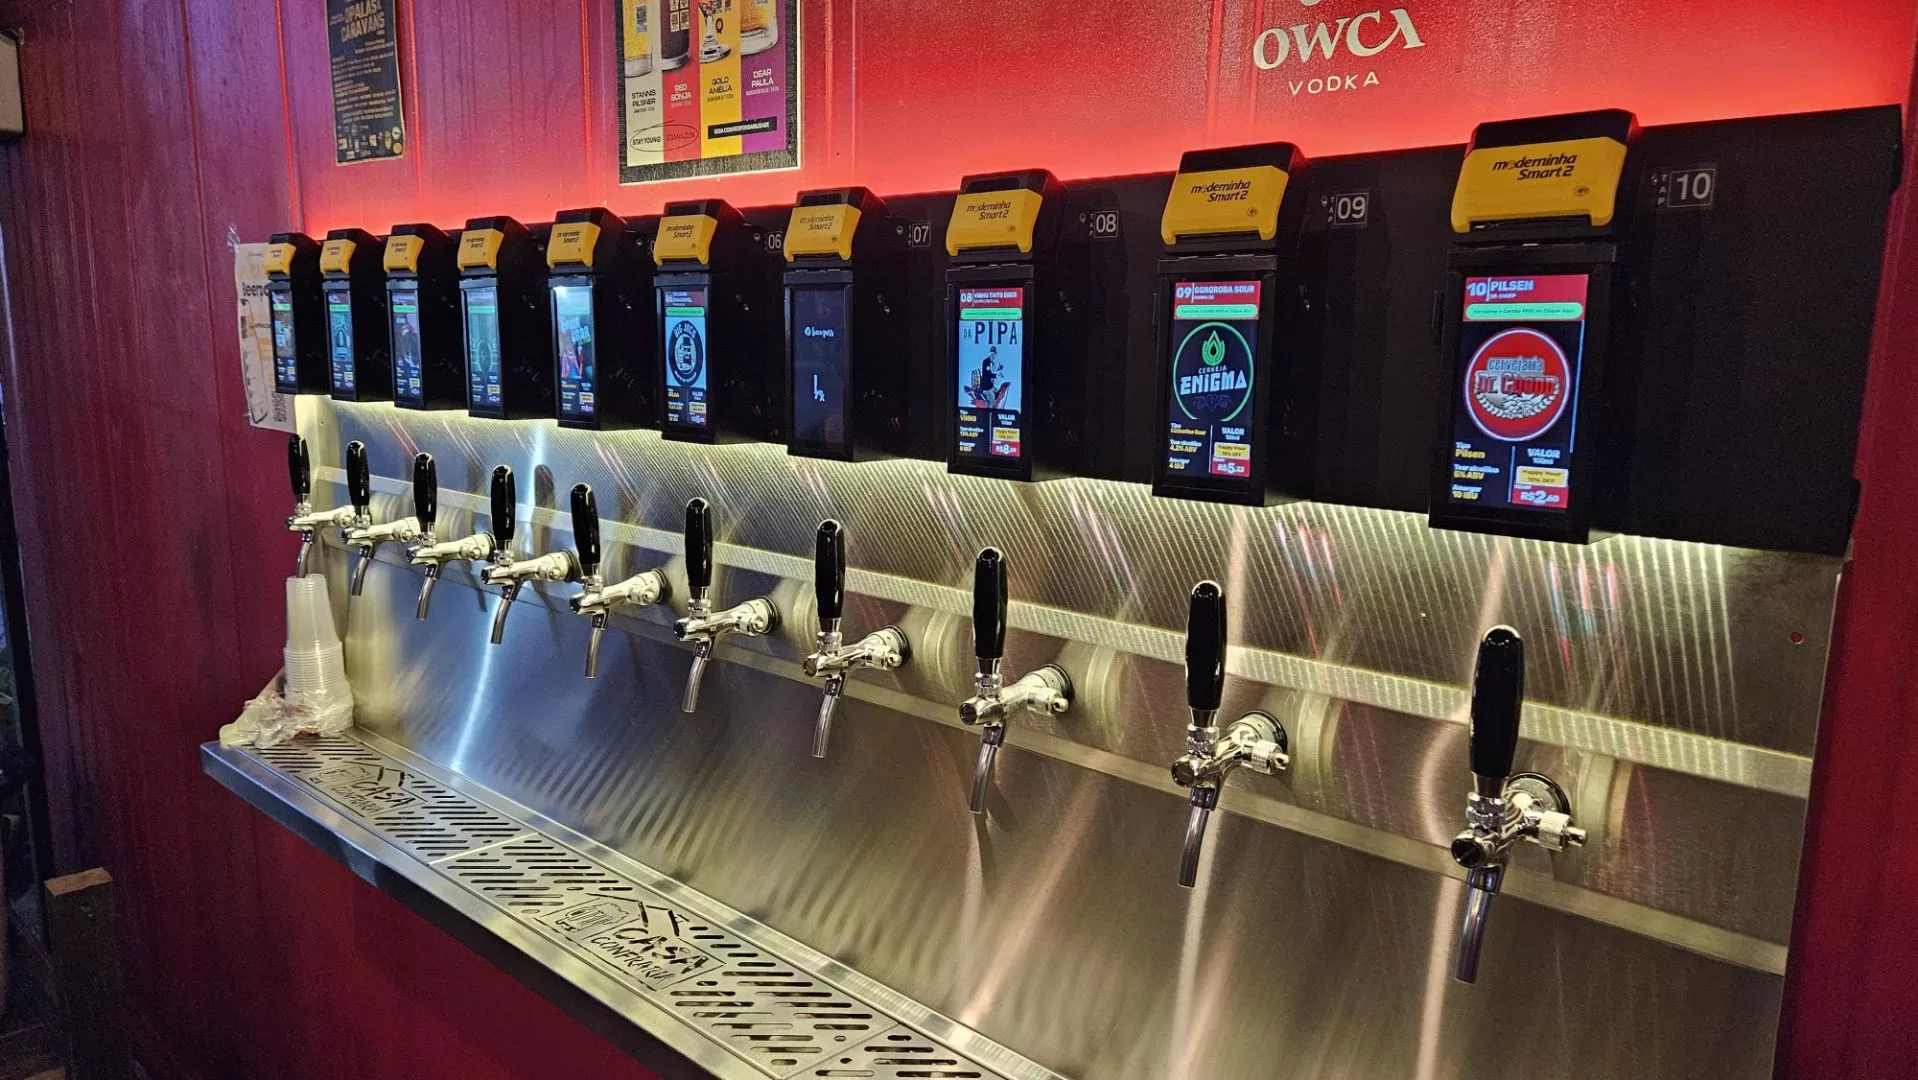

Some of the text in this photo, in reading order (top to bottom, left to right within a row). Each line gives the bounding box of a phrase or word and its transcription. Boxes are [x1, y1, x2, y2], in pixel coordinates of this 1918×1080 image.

[341, 12, 385, 42] CARAVANS
[1253, 8, 1425, 70] OWCA
[753, 69, 772, 79] DEAR
[711, 76, 729, 85] GOLD
[751, 78, 774, 88] PAULA
[1289, 71, 1379, 95] VODKA
[674, 83, 688, 91] RED
[631, 89, 656, 99] STANNIS
[632, 98, 656, 108] PILSNER
[1517, 165, 1575, 181] Smart 2
[1676, 172, 1711, 200] 10
[1208, 191, 1239, 203] Smart
[1337, 196, 1366, 220] 09
[1096, 213, 1117, 233] 08
[913, 225, 929, 244] 07
[768, 233, 782, 249] 06
[1176, 287, 1192, 298] 09
[1234, 285, 1255, 293] SOUR
[1466, 280, 1534, 296] 10 PILSEN
[974, 321, 1018, 344] PIPA
[1198, 365, 1227, 374] CERVEJA
[1221, 427, 1245, 436] VALOR
[1455, 441, 1472, 449] Tipo
[1455, 448, 1486, 459] Pilsen
[1527, 448, 1561, 459] VALOR
[1466, 471, 1485, 480] ABV
[1463, 491, 1479, 500] IBU
[351, 781, 417, 808] CASA
[613, 927, 710, 975] CASA
